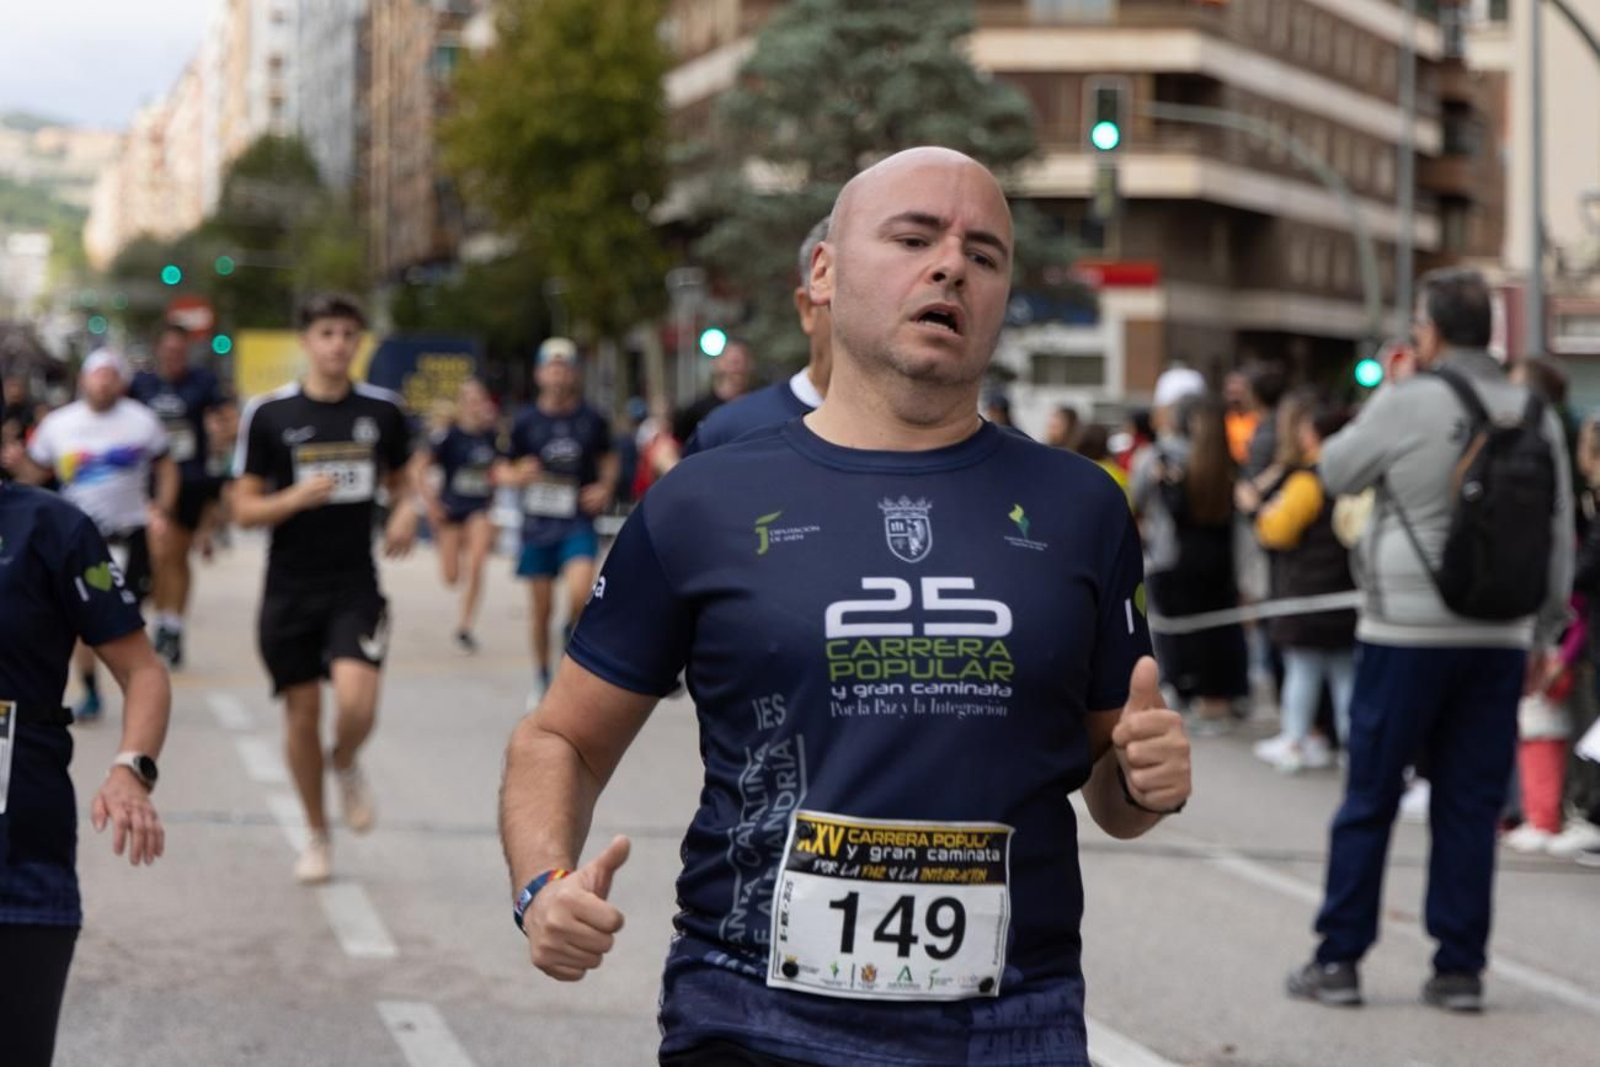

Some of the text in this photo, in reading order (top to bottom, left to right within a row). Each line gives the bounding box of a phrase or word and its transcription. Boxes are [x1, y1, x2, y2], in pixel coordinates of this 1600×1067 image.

[825, 577, 1012, 638] 25
[826, 638, 1011, 660] CARRERA
[830, 659, 1014, 682] POPULAR
[832, 682, 1012, 700] y gran caminata
[752, 694, 786, 731] IES
[830, 701, 855, 717] Por
[858, 699, 870, 716] la
[875, 698, 898, 715] Paz
[899, 703, 908, 719] y
[914, 697, 926, 714] la
[848, 830, 928, 846] CARRERA
[933, 832, 988, 849] POPUL
[847, 844, 1000, 862] y gran caminata
[840, 862, 860, 877] LA
[899, 867, 918, 880] LA
[727, 877, 761, 948] ANTA
[828, 891, 966, 960] 149
